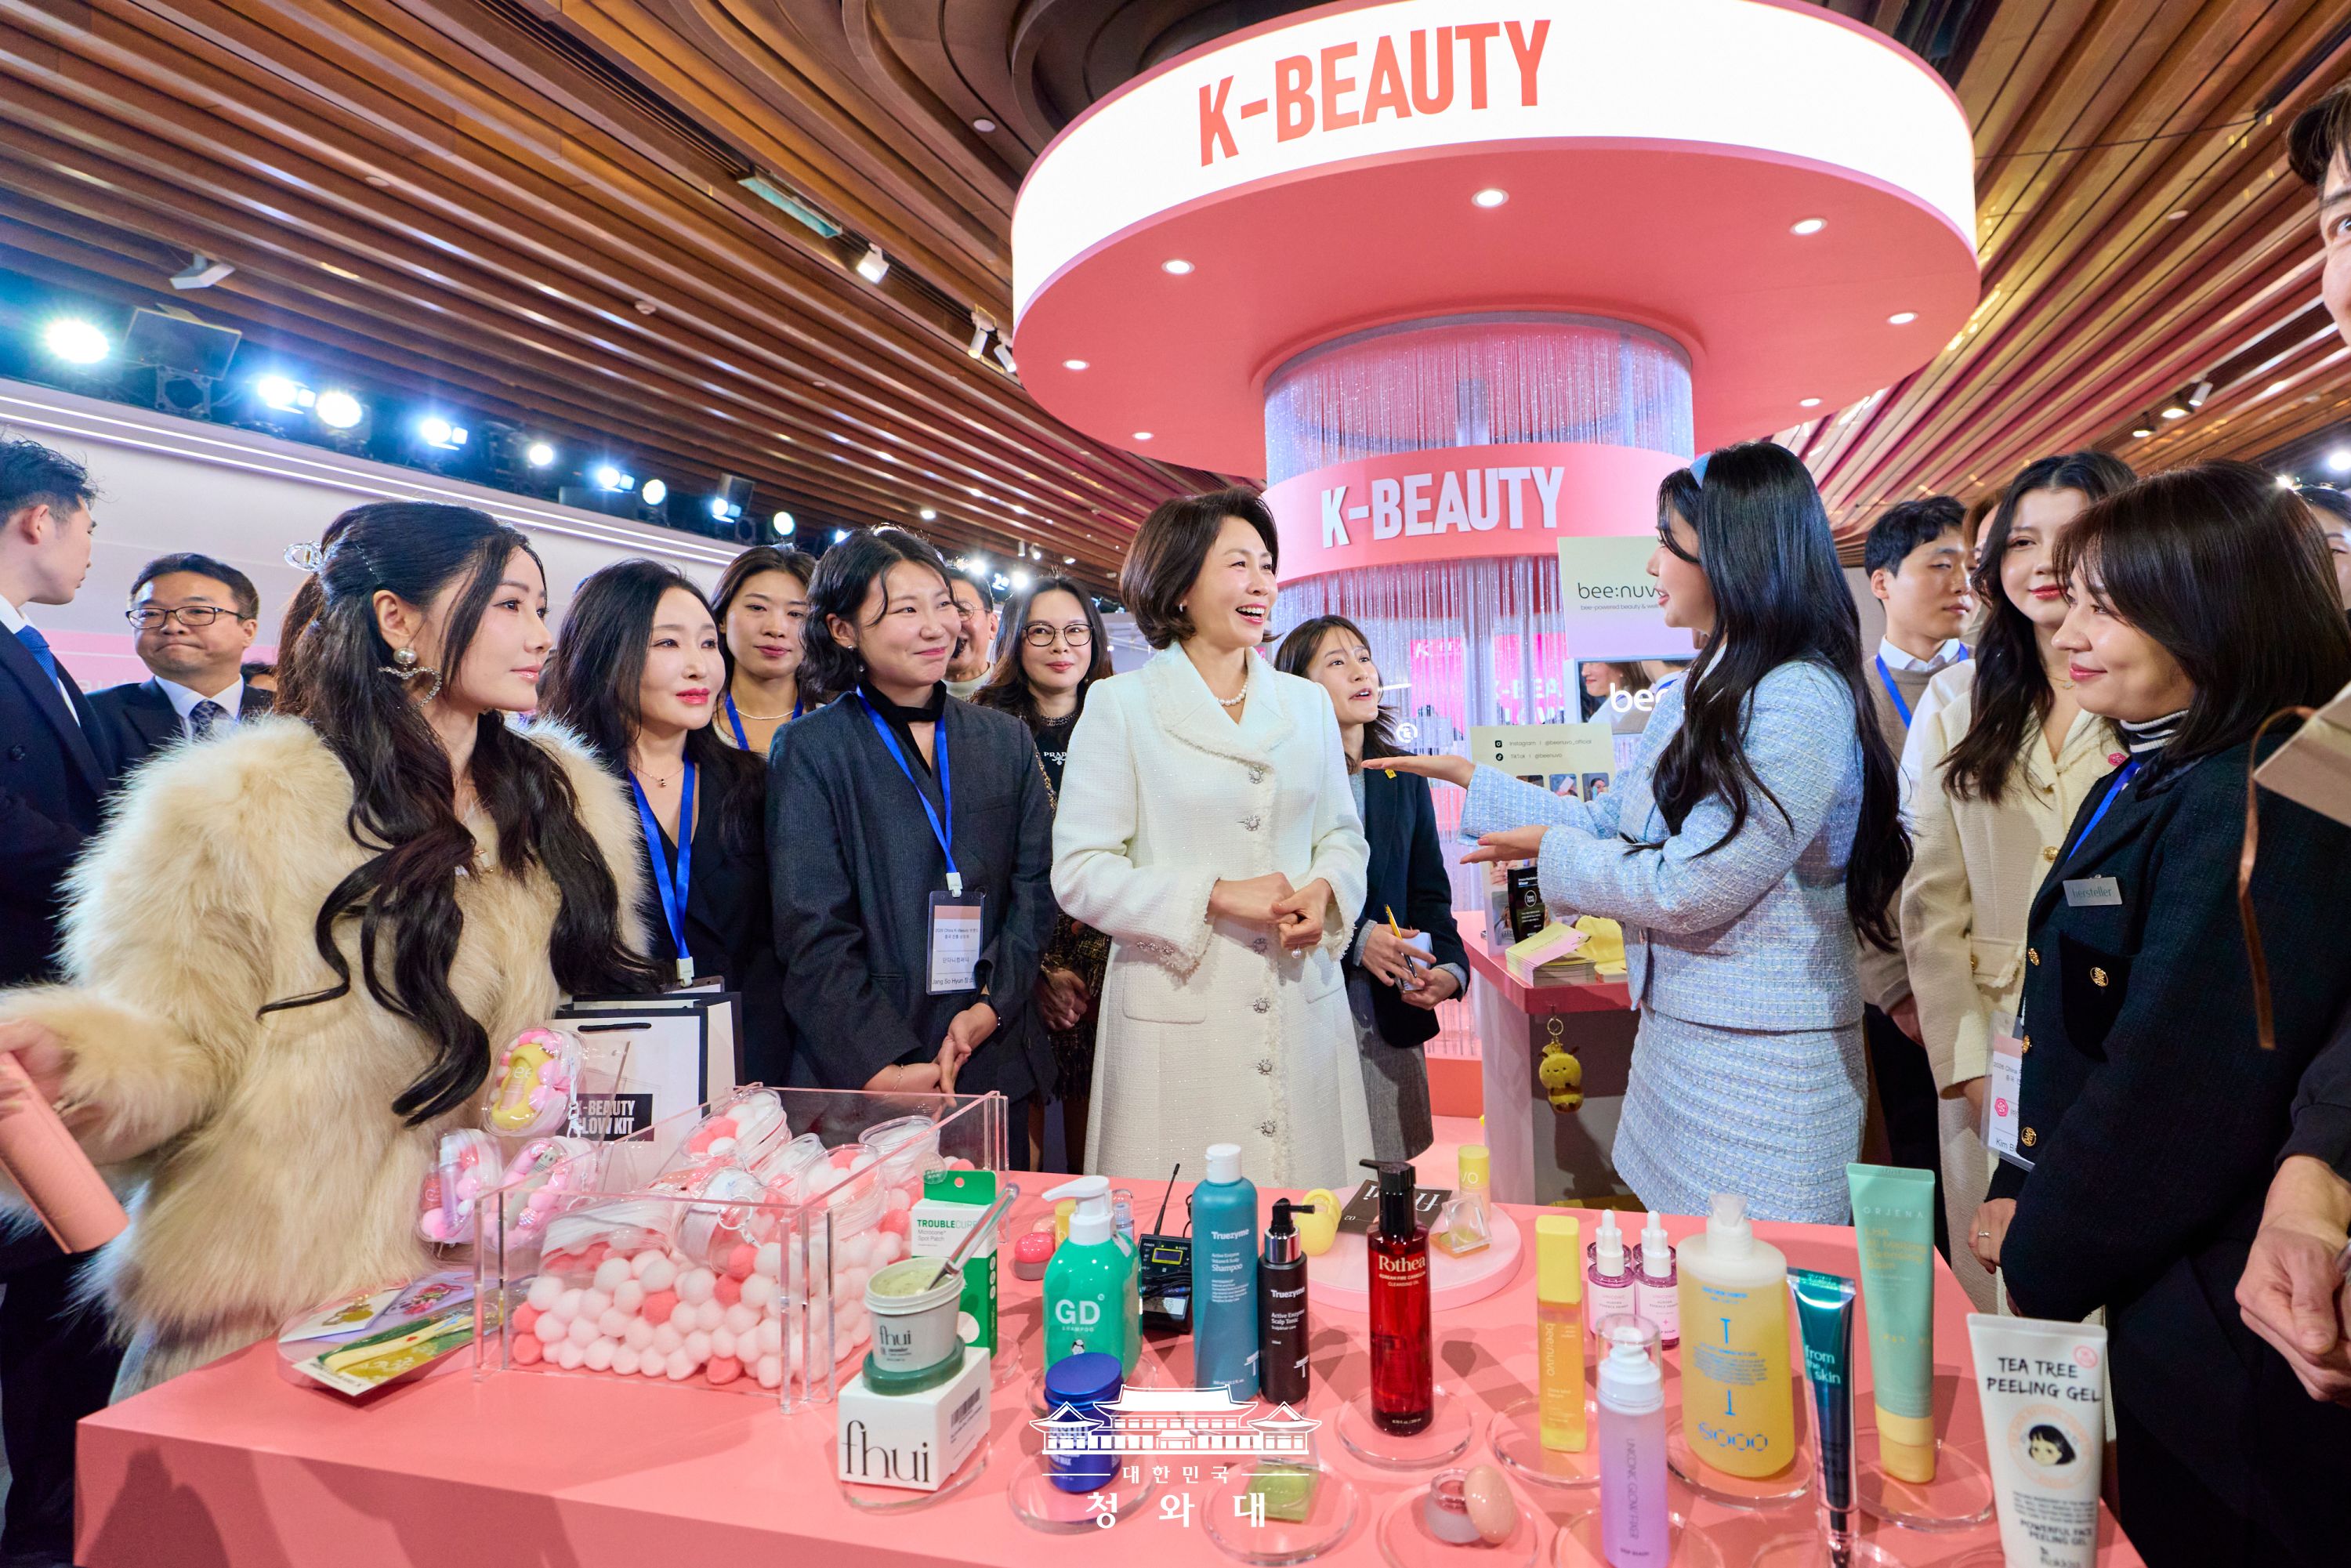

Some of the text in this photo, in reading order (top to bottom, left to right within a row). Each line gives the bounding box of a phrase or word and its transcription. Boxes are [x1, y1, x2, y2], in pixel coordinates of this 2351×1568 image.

[1198, 20, 1551, 166] K-BEAUTY
[1321, 466, 1564, 548] K-BEAUTY
[1578, 583, 1657, 599] bee:nuv
[2072, 886, 2113, 899] hersteller
[614, 1117, 635, 1135] KIT
[1995, 1138, 2008, 1149] Kim
[1863, 1206, 1924, 1219] ORJENA
[1211, 1229, 1250, 1240] Truezyme
[1212, 1264, 1243, 1273] Shampoo
[1378, 1255, 1425, 1272] Rothea
[1270, 1286, 1306, 1298] Truezyme
[1056, 1299, 1100, 1324] GD
[879, 1324, 911, 1345] fhui
[1545, 1323, 1556, 1377] bee:nuvo
[1804, 1345, 1835, 1364] from
[1998, 1357, 2079, 1378] TEA TREE
[1814, 1368, 1841, 1385] skin
[1987, 1377, 2102, 1403] PEELING GEL
[842, 1420, 929, 1483] fhui
[2029, 1530, 2069, 1545] PEELING
